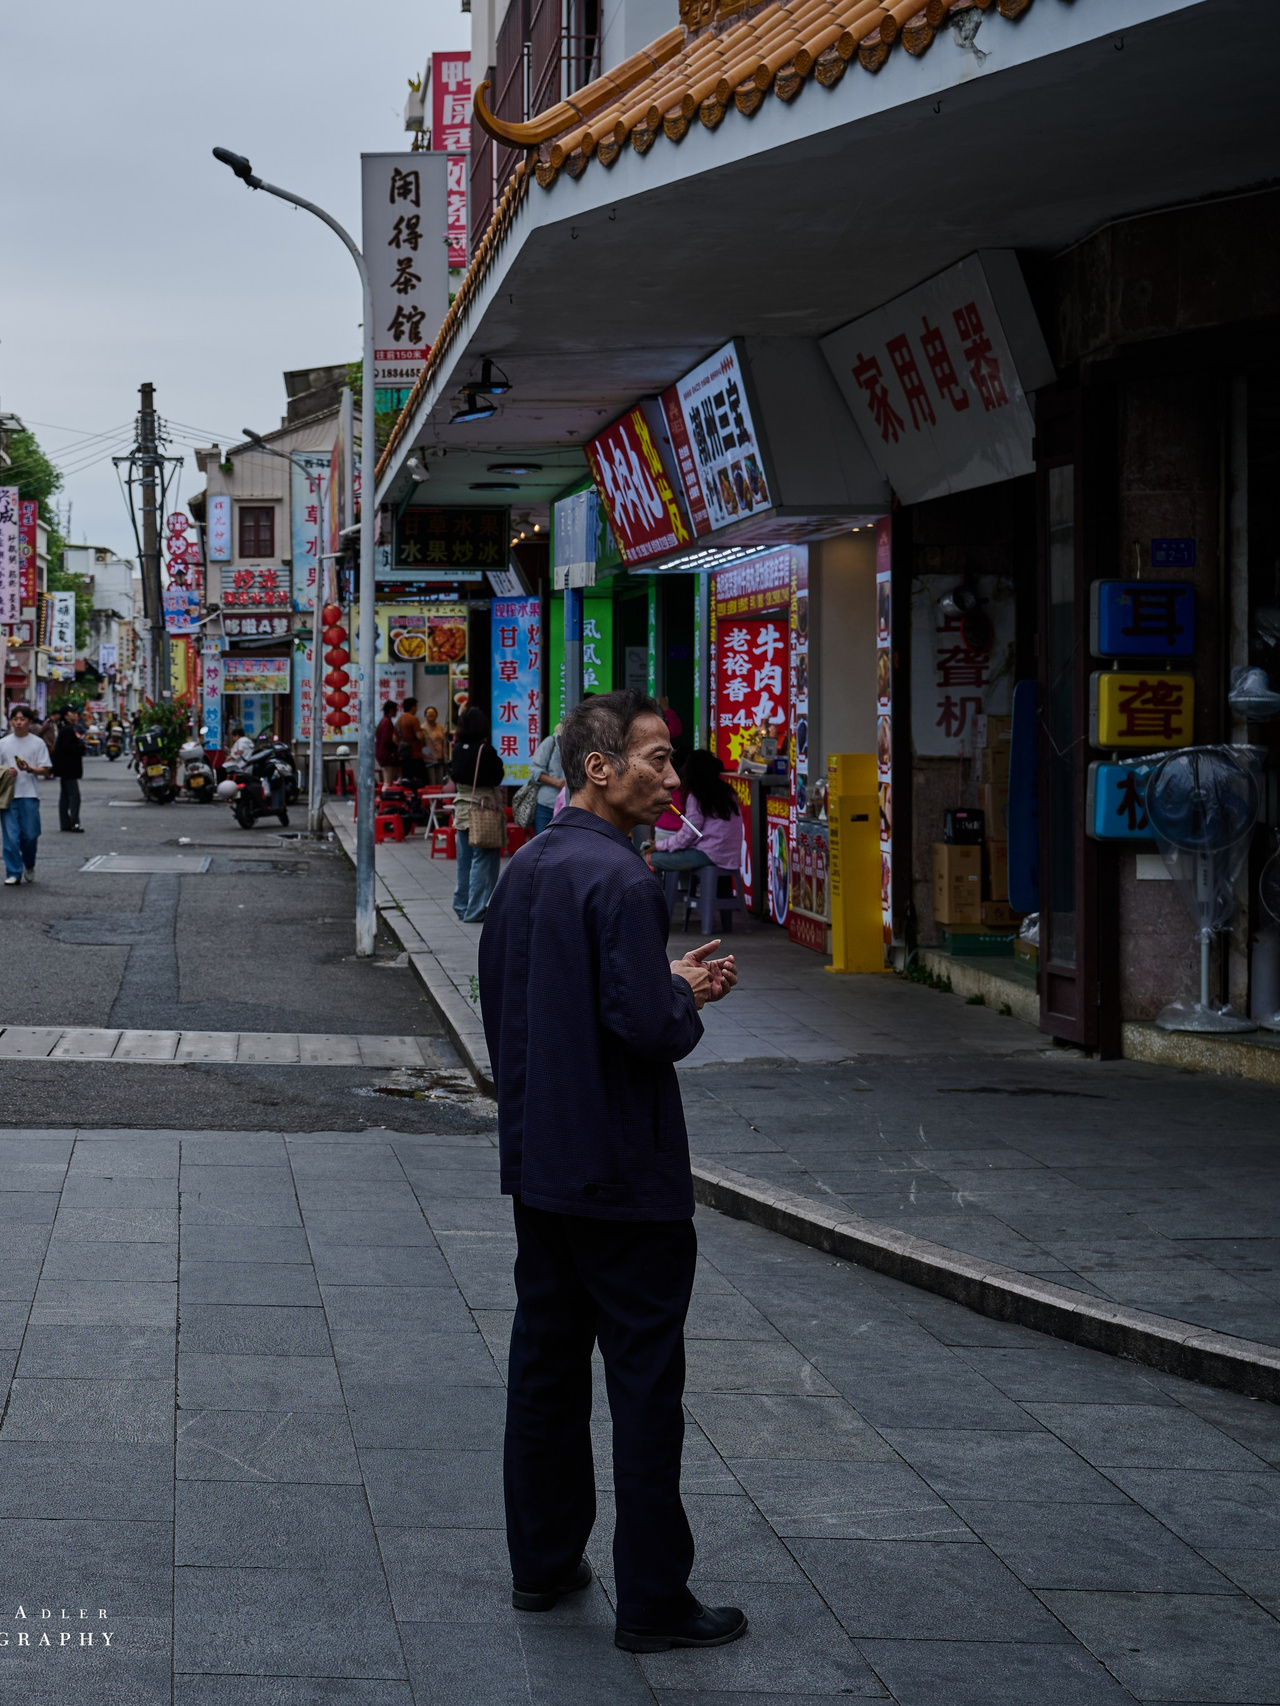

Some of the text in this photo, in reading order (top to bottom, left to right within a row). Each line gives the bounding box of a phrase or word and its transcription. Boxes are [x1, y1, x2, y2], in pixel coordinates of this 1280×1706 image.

[852, 301, 1009, 444] 家用电器
[401, 513, 500, 537] 甘草水果
[400, 539, 500, 564] 水果炒冰
[224, 617, 289, 635] 哆啦A梦
[225, 660, 287, 674] 甘草水果
[722, 627, 753, 703] 老裕香
[752, 623, 786, 727] 牛肉丸
[498, 625, 519, 757] 甘草水果
